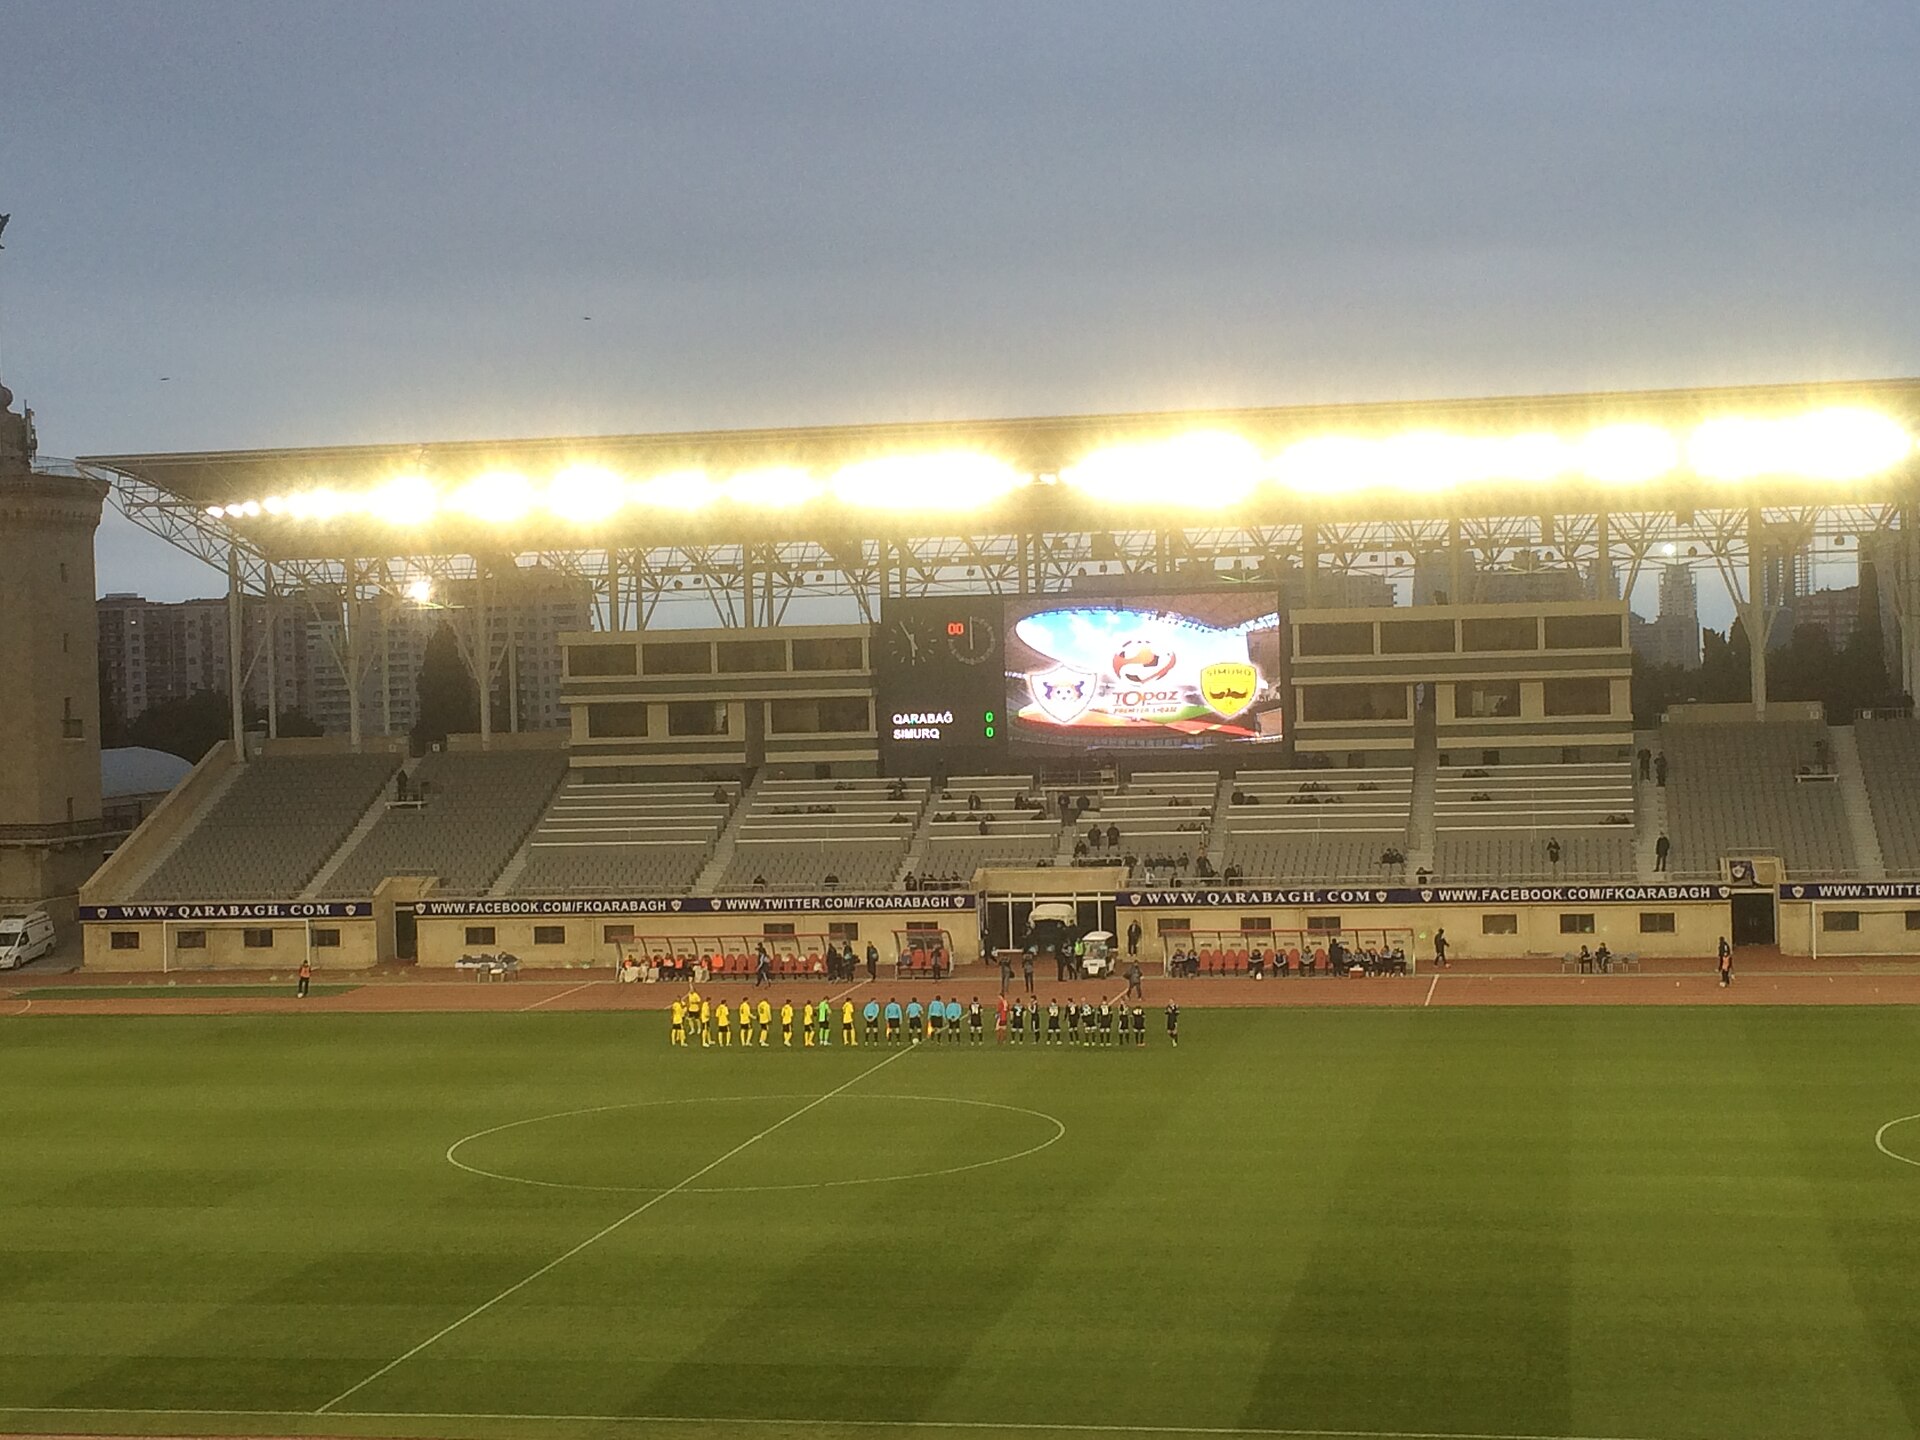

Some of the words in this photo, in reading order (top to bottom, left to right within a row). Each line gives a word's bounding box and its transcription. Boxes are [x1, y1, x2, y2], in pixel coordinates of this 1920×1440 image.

[985, 711, 994, 723] 0
[893, 728, 940, 739] SIMURQ
[986, 727, 994, 738] 0
[1438, 887, 1711, 901] WWW.FACEBOOK.COM/FKQARABAGH
[431, 900, 666, 914] WWW.FACEBOOK.COM/FKQARABAGH
[726, 896, 950, 910] WWW.TWITTER.COM/FKQARABAGH
